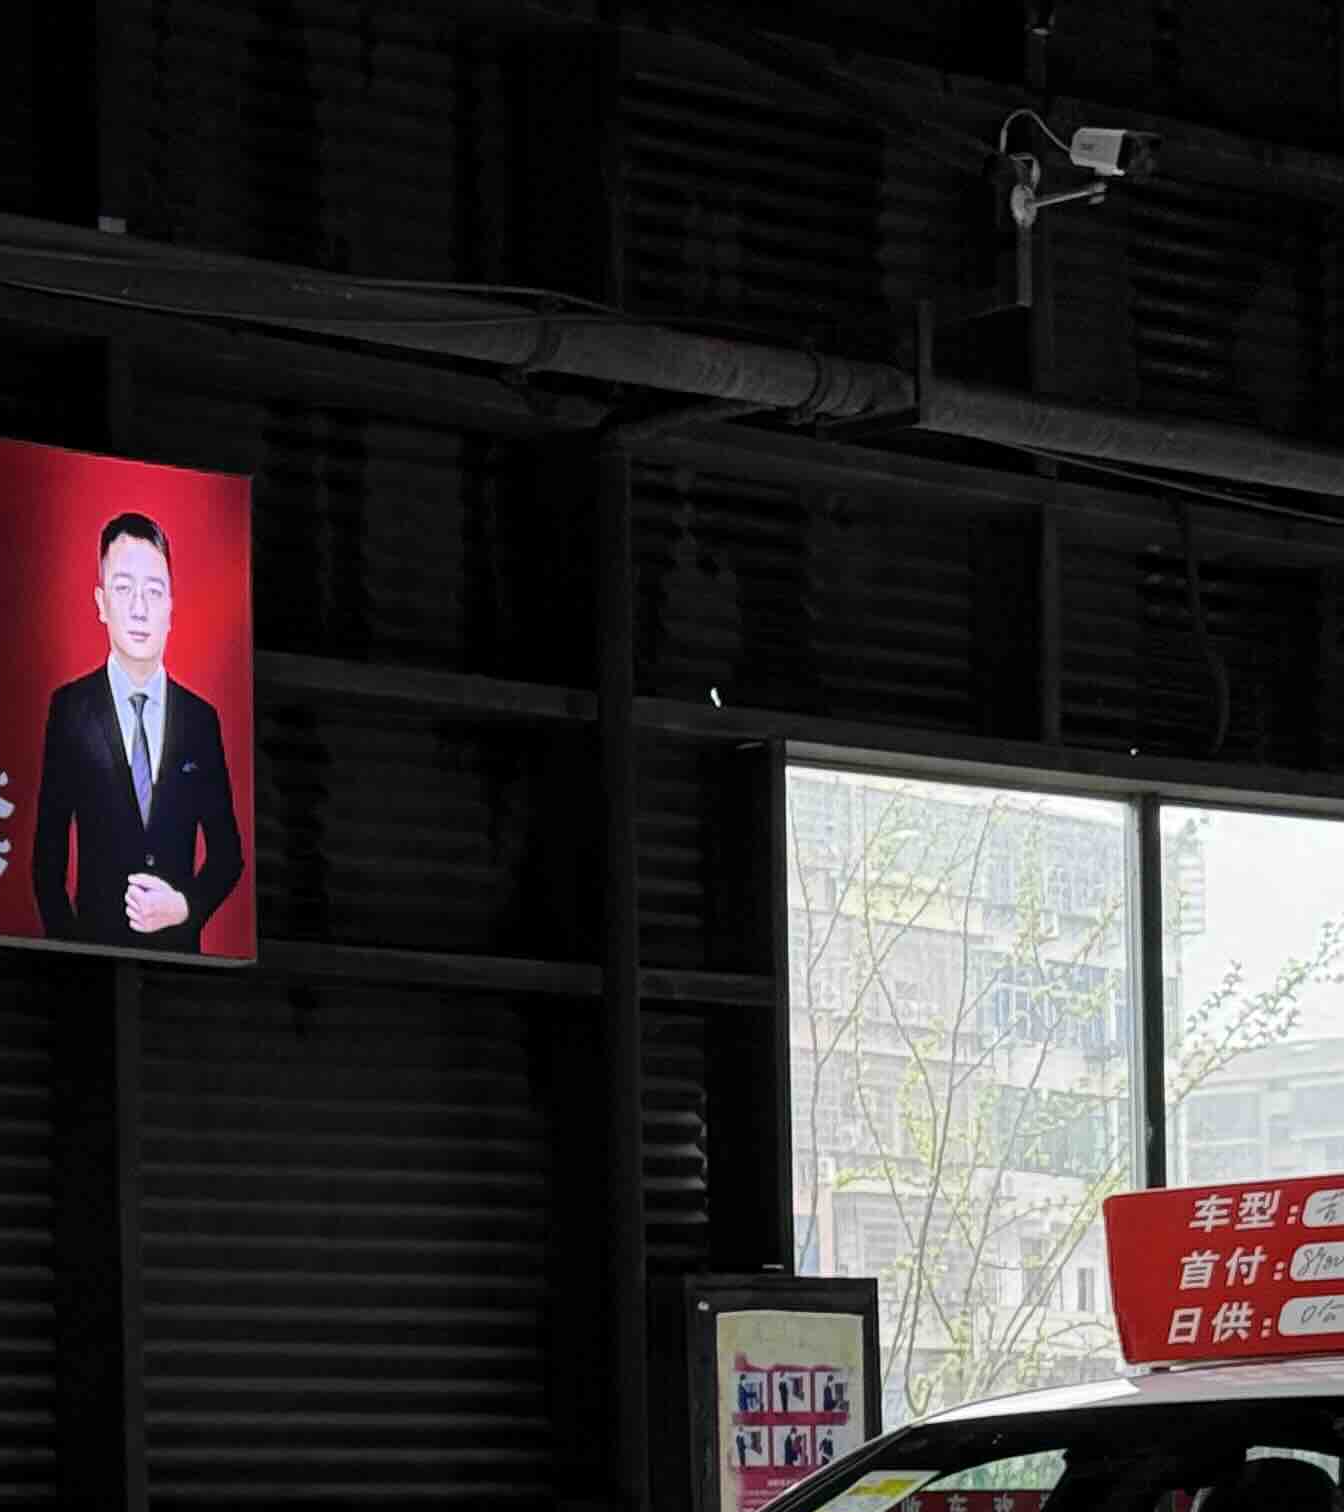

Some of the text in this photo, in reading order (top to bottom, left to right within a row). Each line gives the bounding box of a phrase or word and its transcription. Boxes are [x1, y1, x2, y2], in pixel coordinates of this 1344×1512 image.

[1188, 1189, 1299, 1232] 车型：
[1179, 1246, 1285, 1291] 首付：
[1167, 1301, 1273, 1345] 日供：
